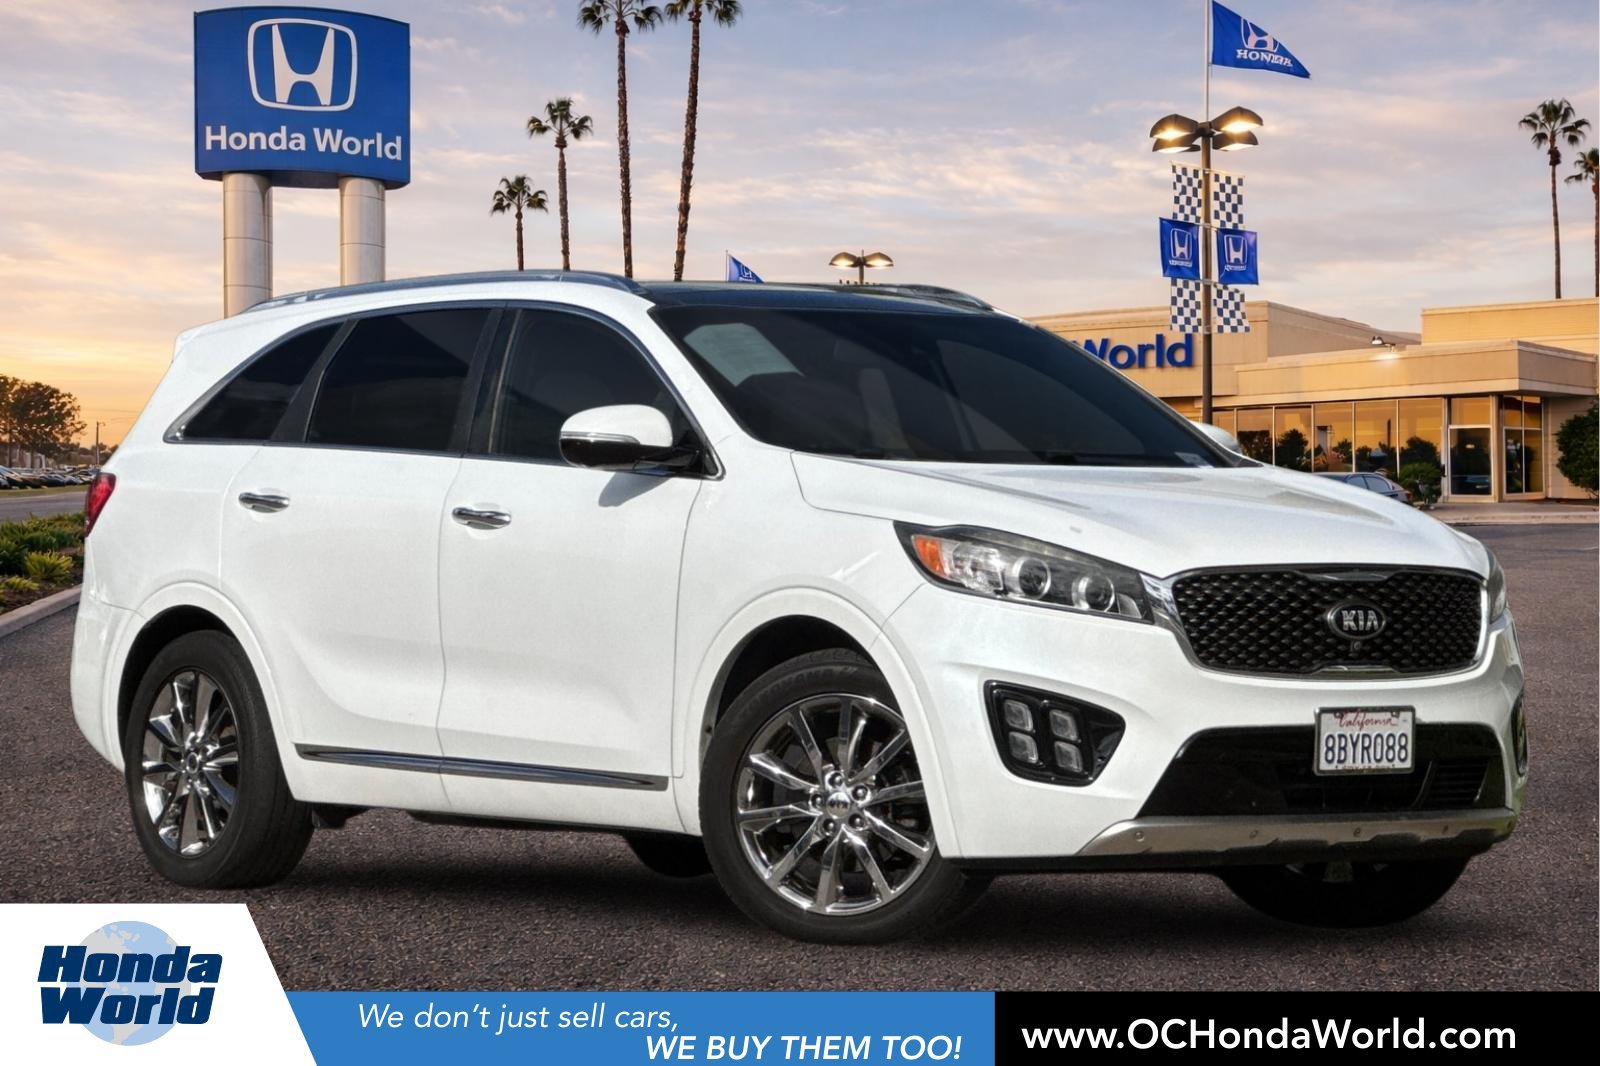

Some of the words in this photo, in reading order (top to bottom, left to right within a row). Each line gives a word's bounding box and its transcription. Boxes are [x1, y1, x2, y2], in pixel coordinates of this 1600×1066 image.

[205, 125, 306, 151] Honda
[313, 127, 402, 161] World
[1341, 610, 1379, 631] KIA
[1339, 709, 1398, 731] California
[1324, 733, 1409, 765] 8BYR088
